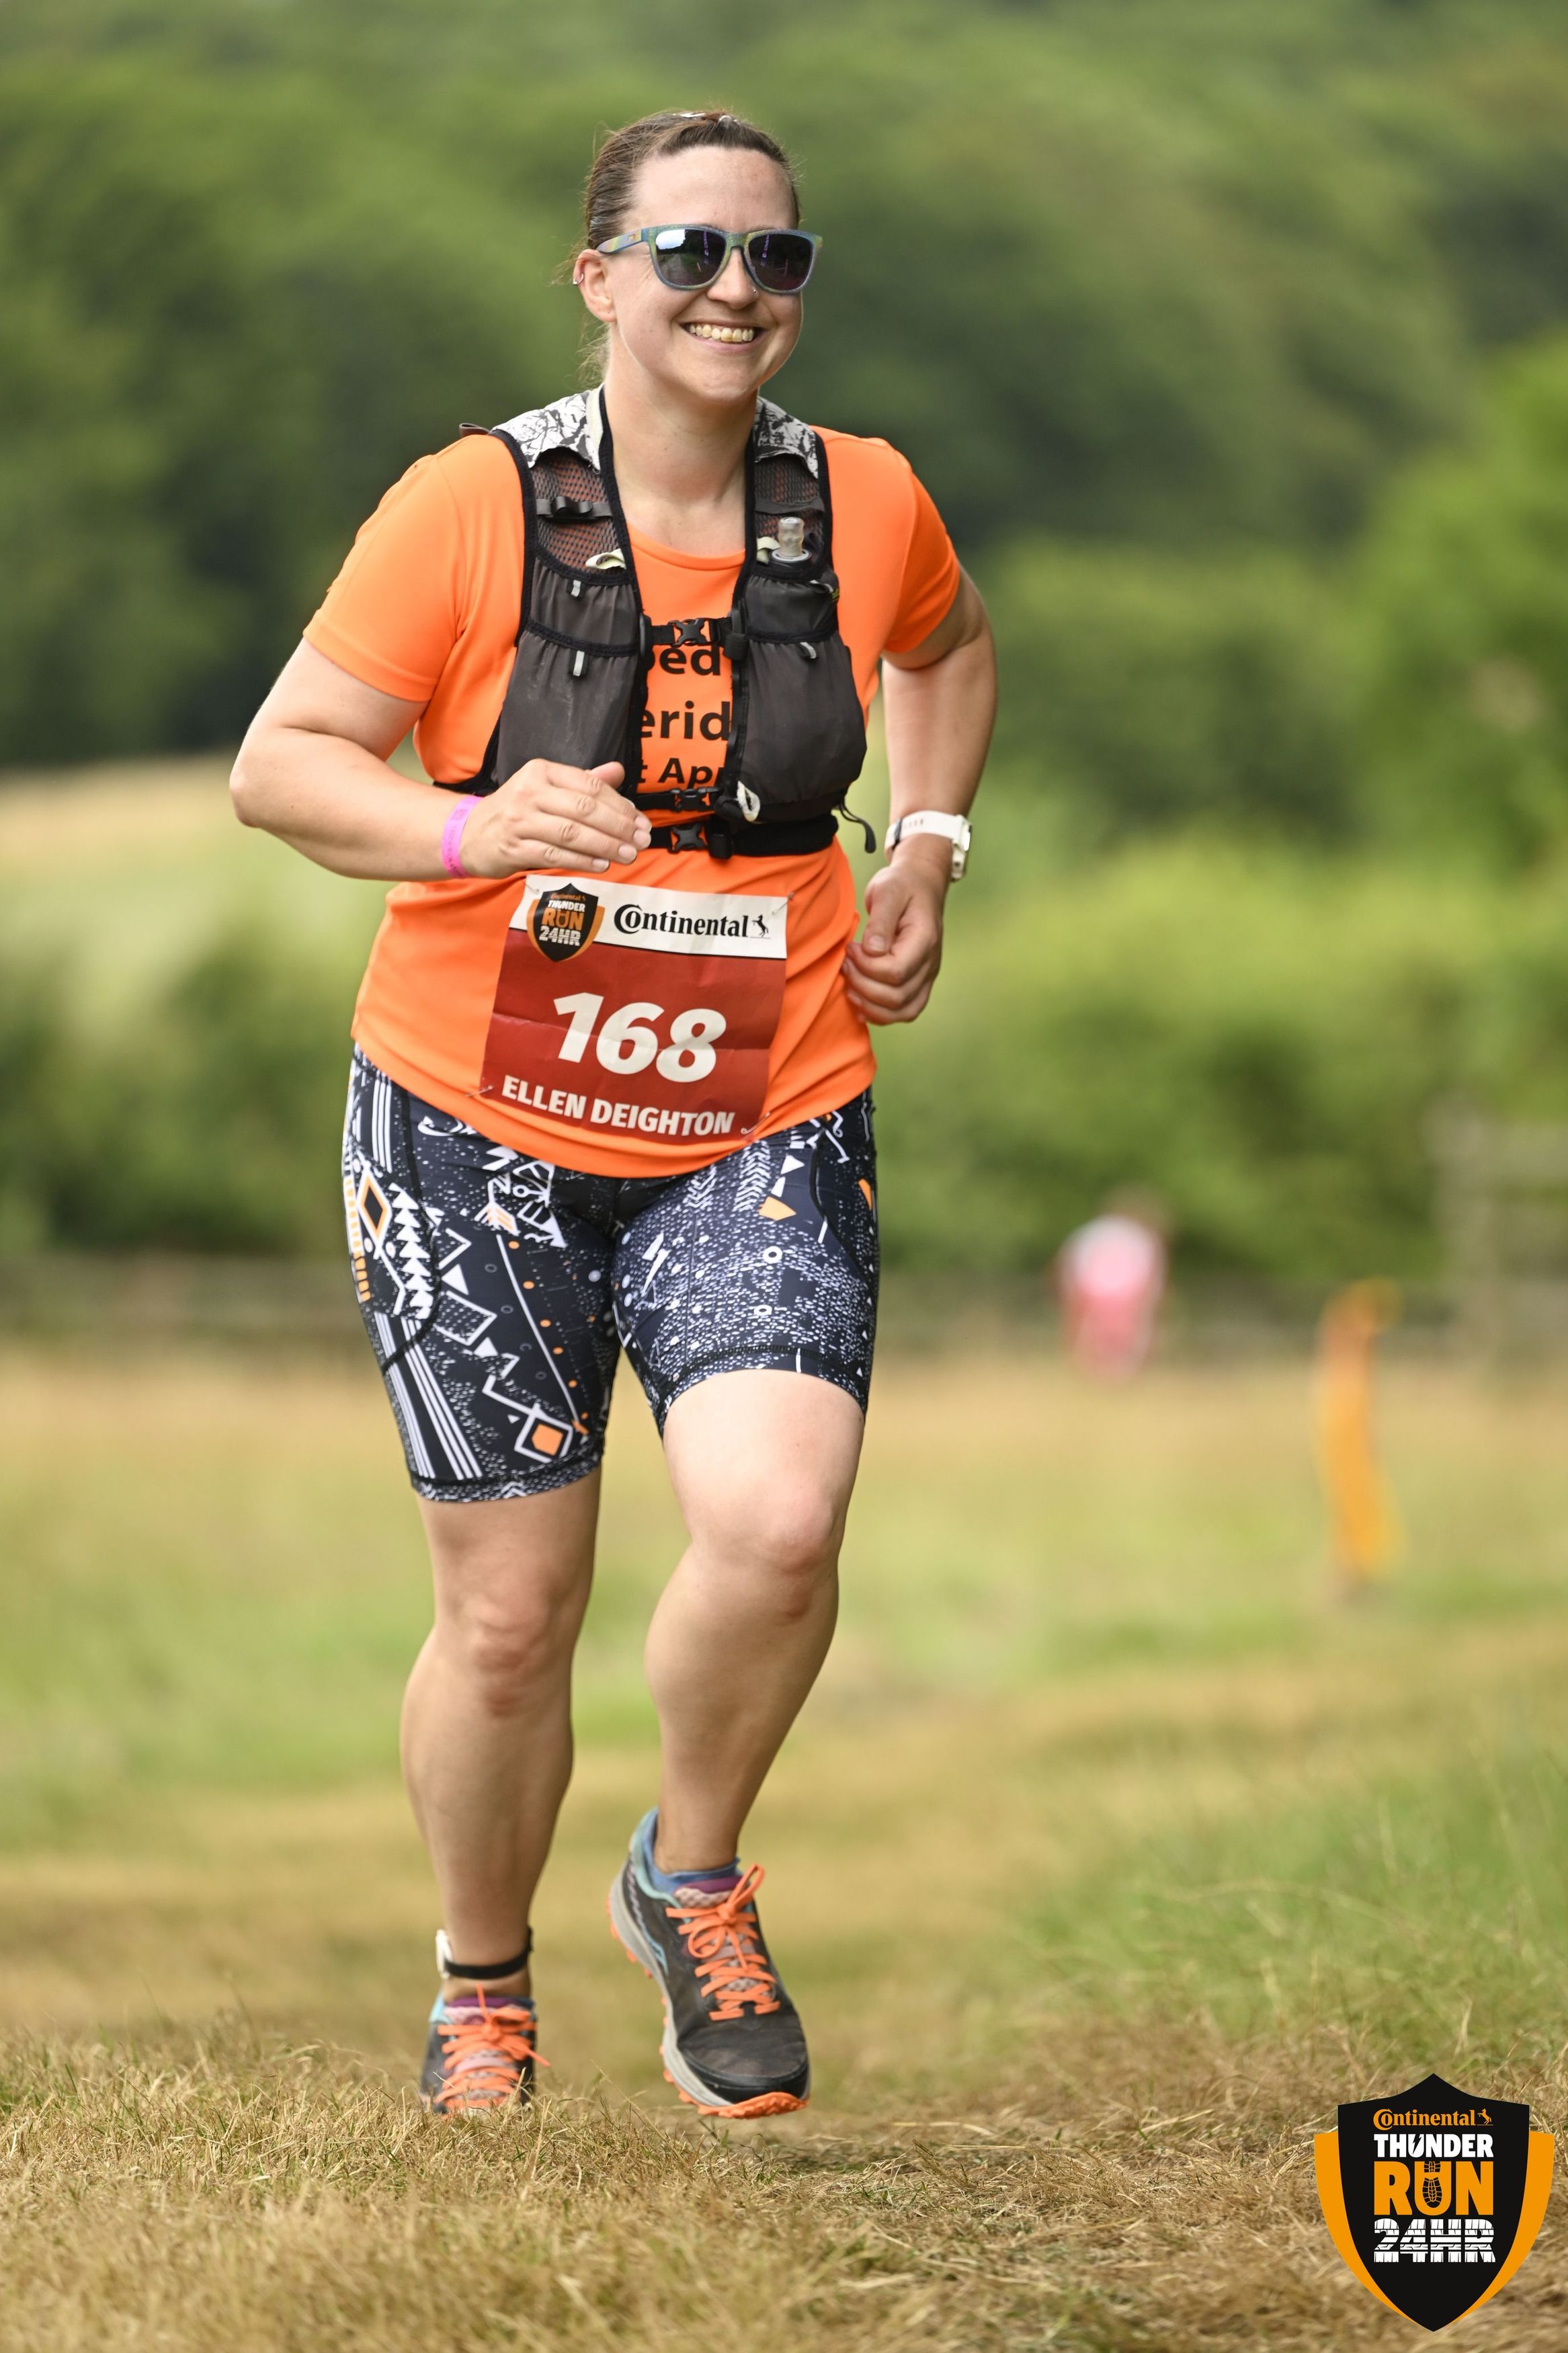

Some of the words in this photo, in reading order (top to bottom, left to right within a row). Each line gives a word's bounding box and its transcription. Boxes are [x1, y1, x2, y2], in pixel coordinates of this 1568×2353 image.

[542, 907, 585, 931] RUN
[547, 900, 586, 912] THUNDER
[538, 925, 581, 947] 24HR
[614, 904, 749, 939] Continental
[553, 992, 727, 1083] 168
[501, 1074, 587, 1119] ELLEN
[590, 1098, 735, 1136] DEIGHTON
